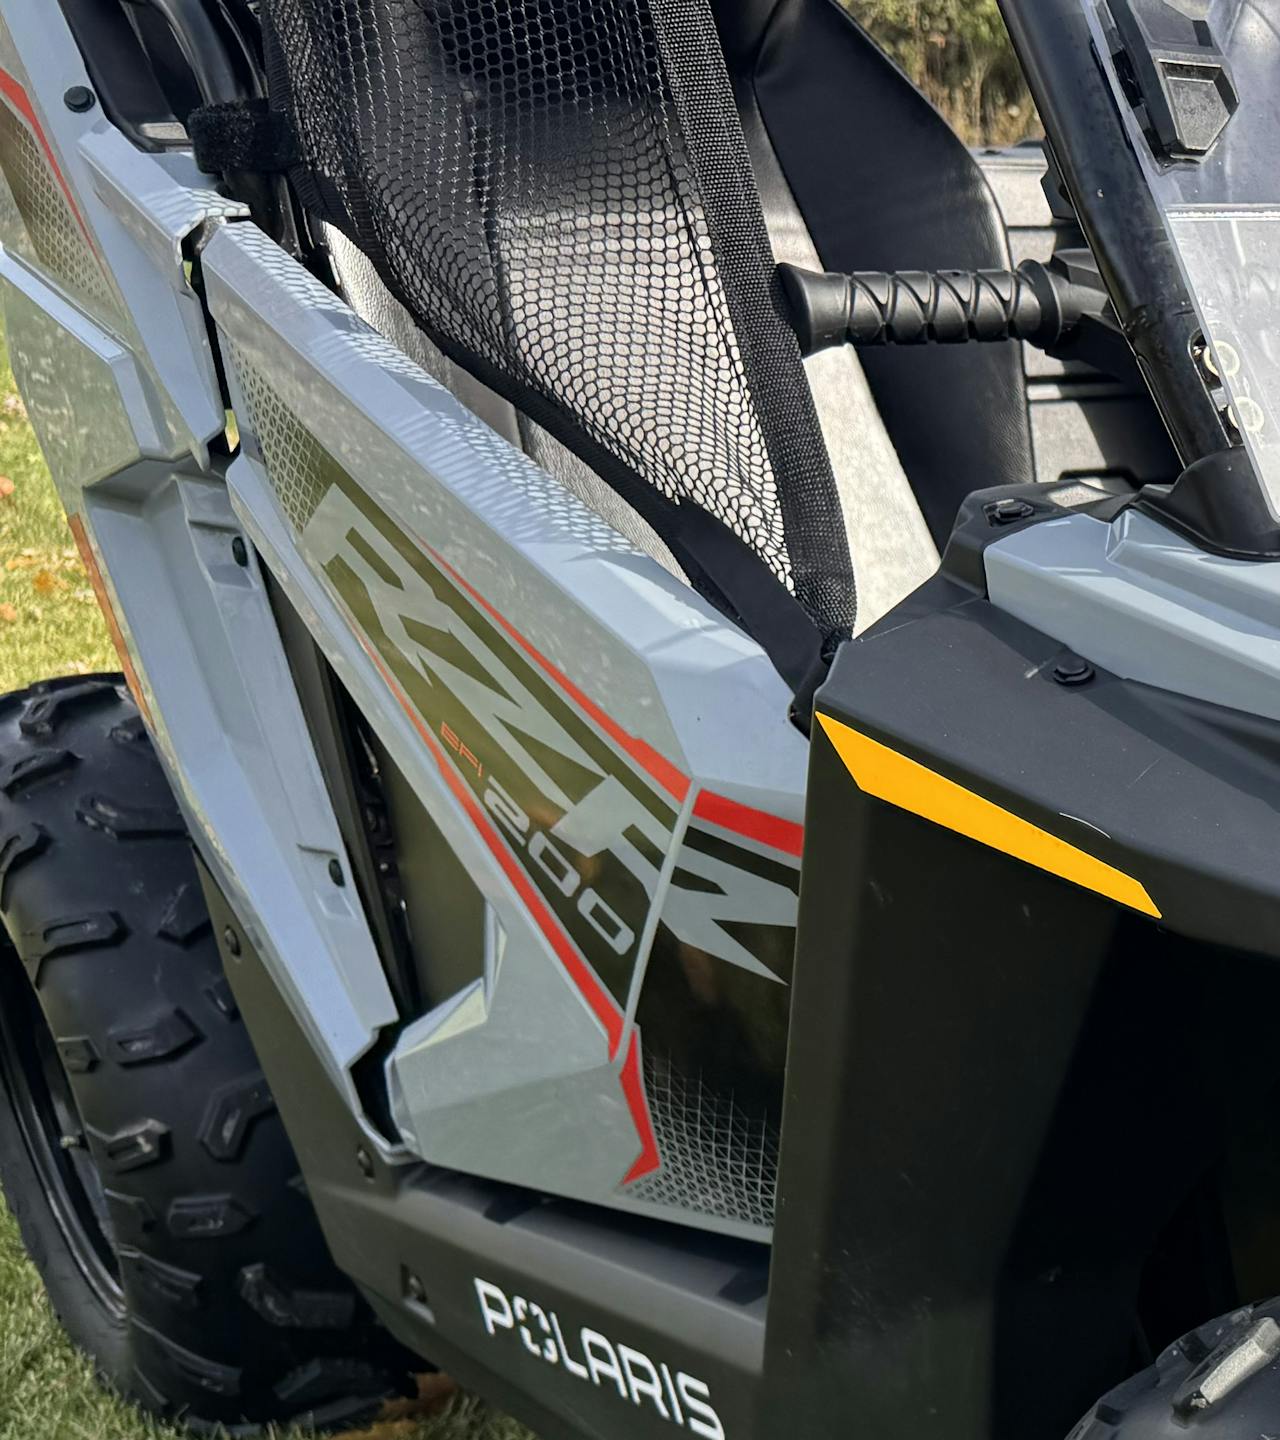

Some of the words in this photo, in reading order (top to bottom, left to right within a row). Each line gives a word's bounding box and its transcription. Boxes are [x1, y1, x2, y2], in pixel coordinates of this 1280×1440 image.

[302, 483, 799, 985] RZR
[440, 721, 484, 778] EFI
[483, 775, 635, 955] 200
